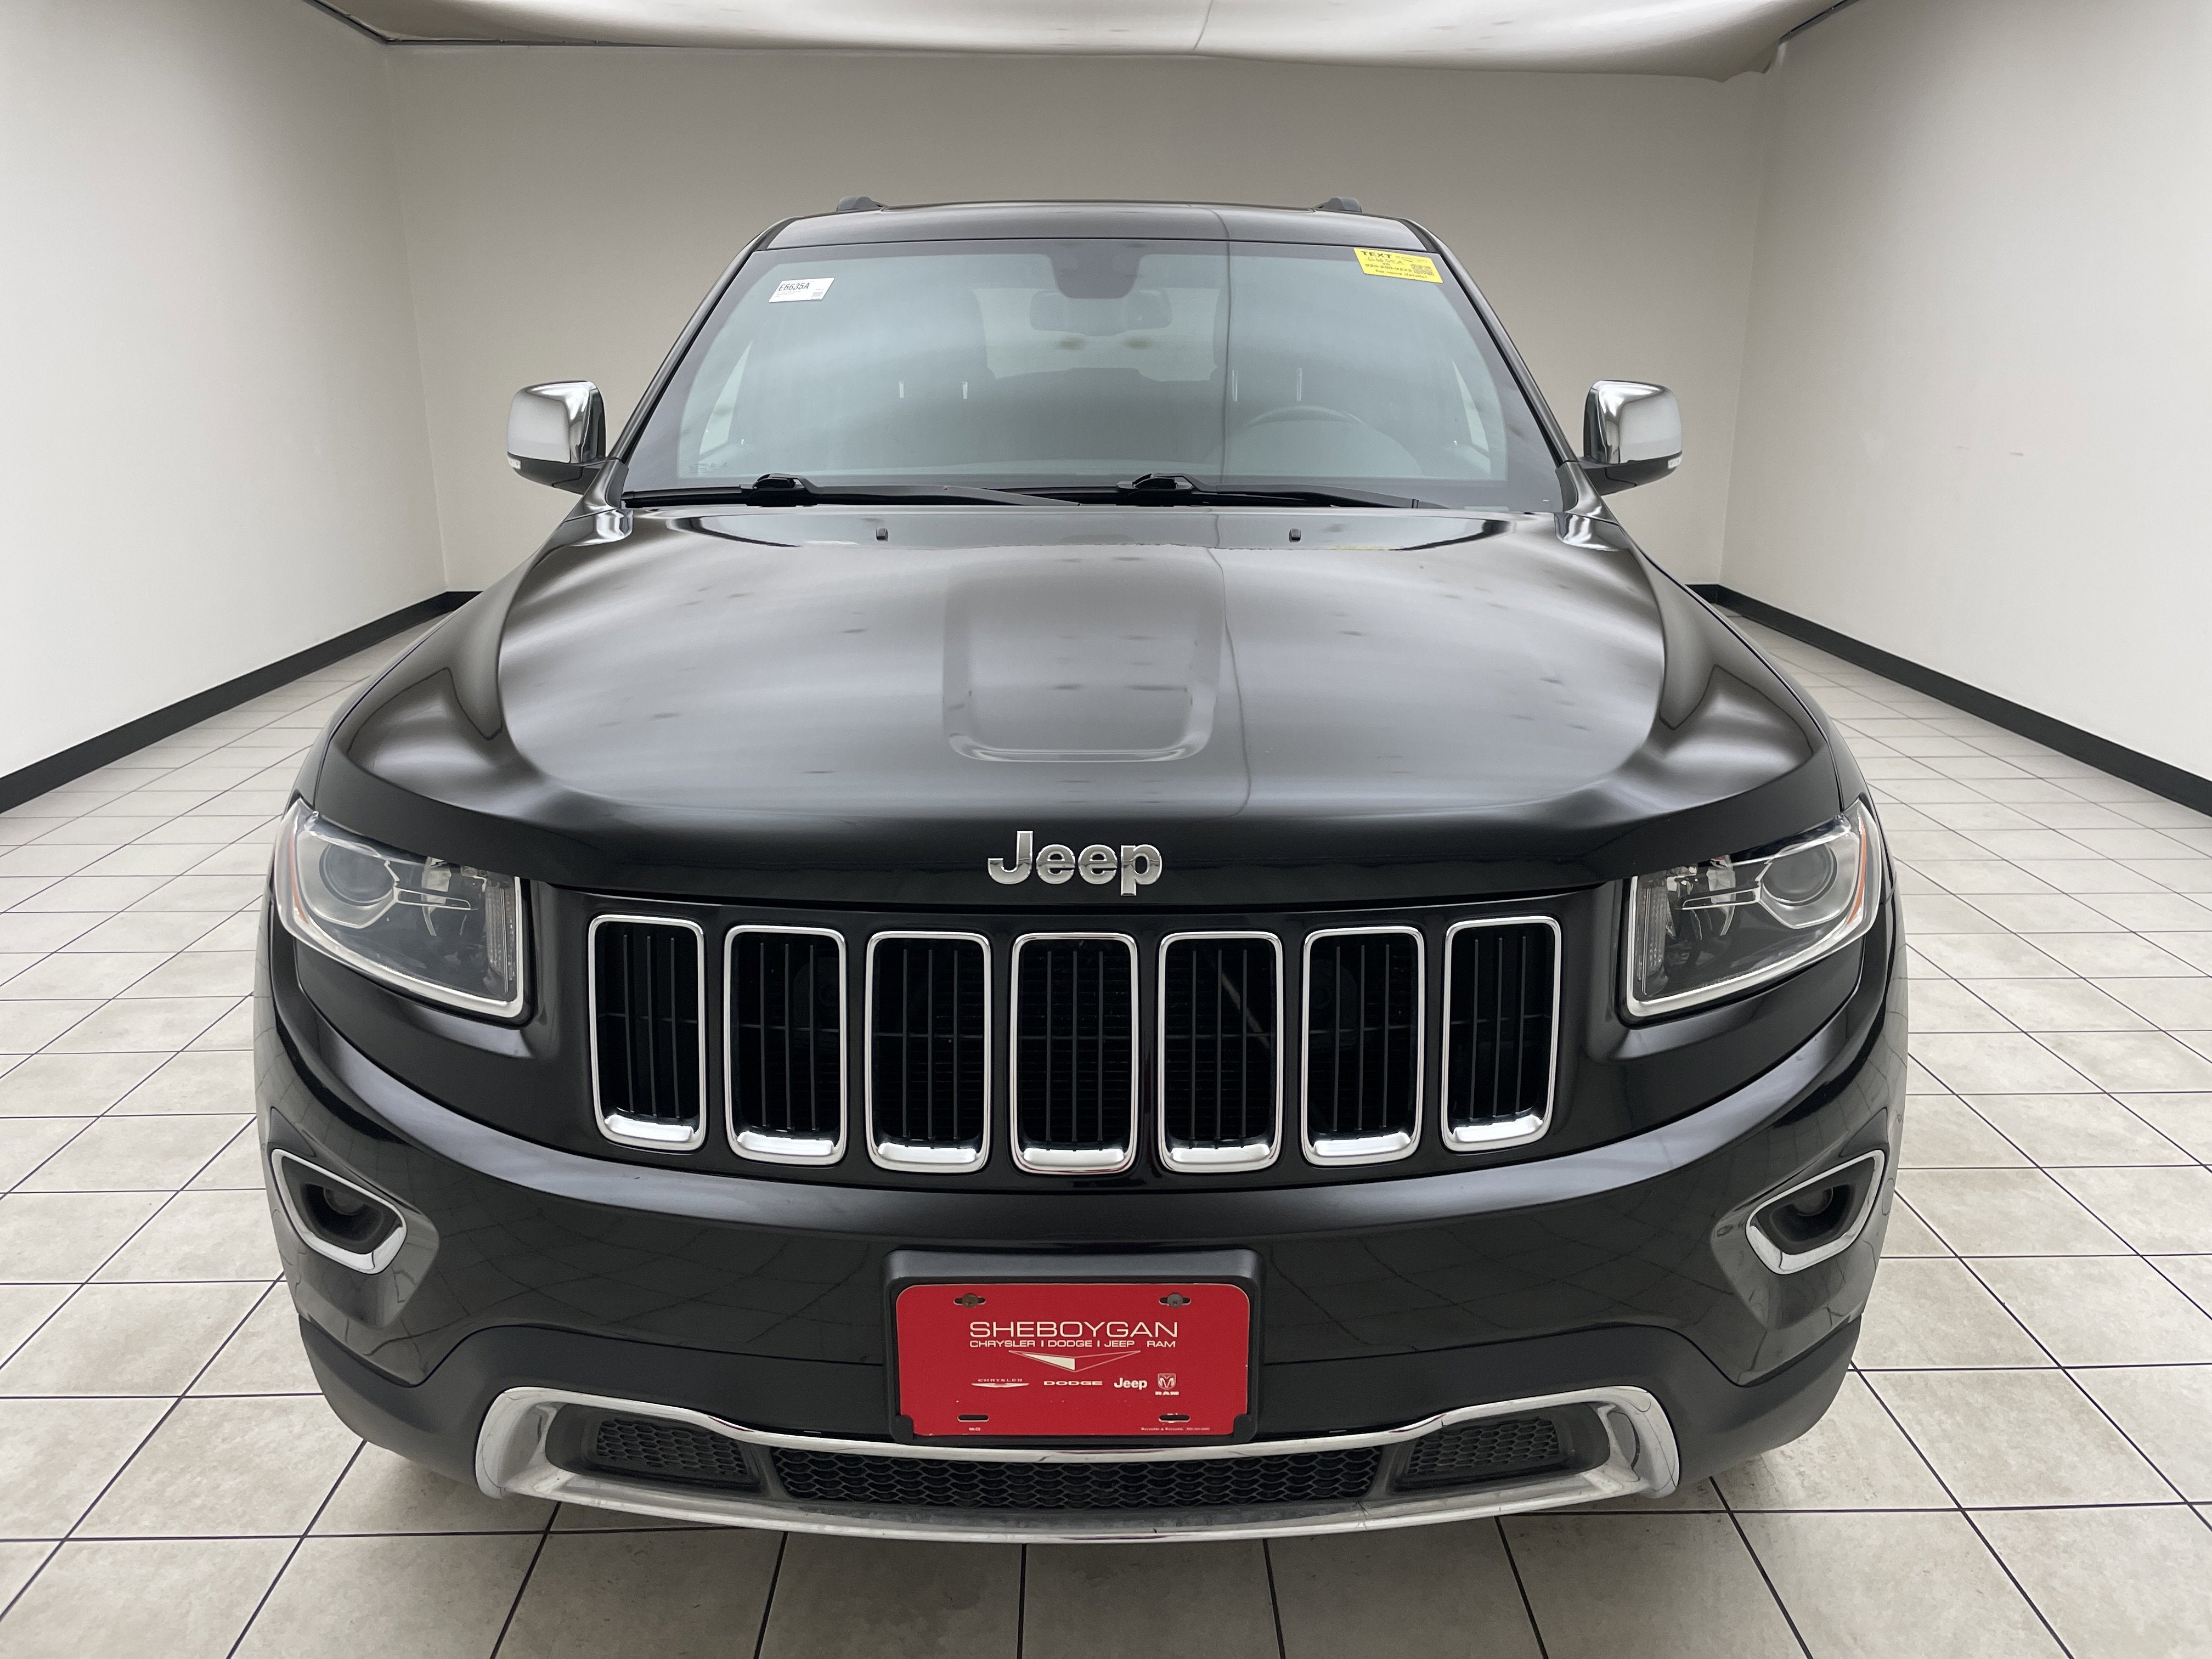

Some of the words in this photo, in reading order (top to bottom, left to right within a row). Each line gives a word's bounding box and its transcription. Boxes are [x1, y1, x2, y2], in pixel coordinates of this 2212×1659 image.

[778, 283, 810, 291] E6635A
[988, 831, 1163, 896] Jeep
[970, 1322, 1178, 1338] SHEBOYGAN
[1113, 1377, 1148, 1390] Jeep
